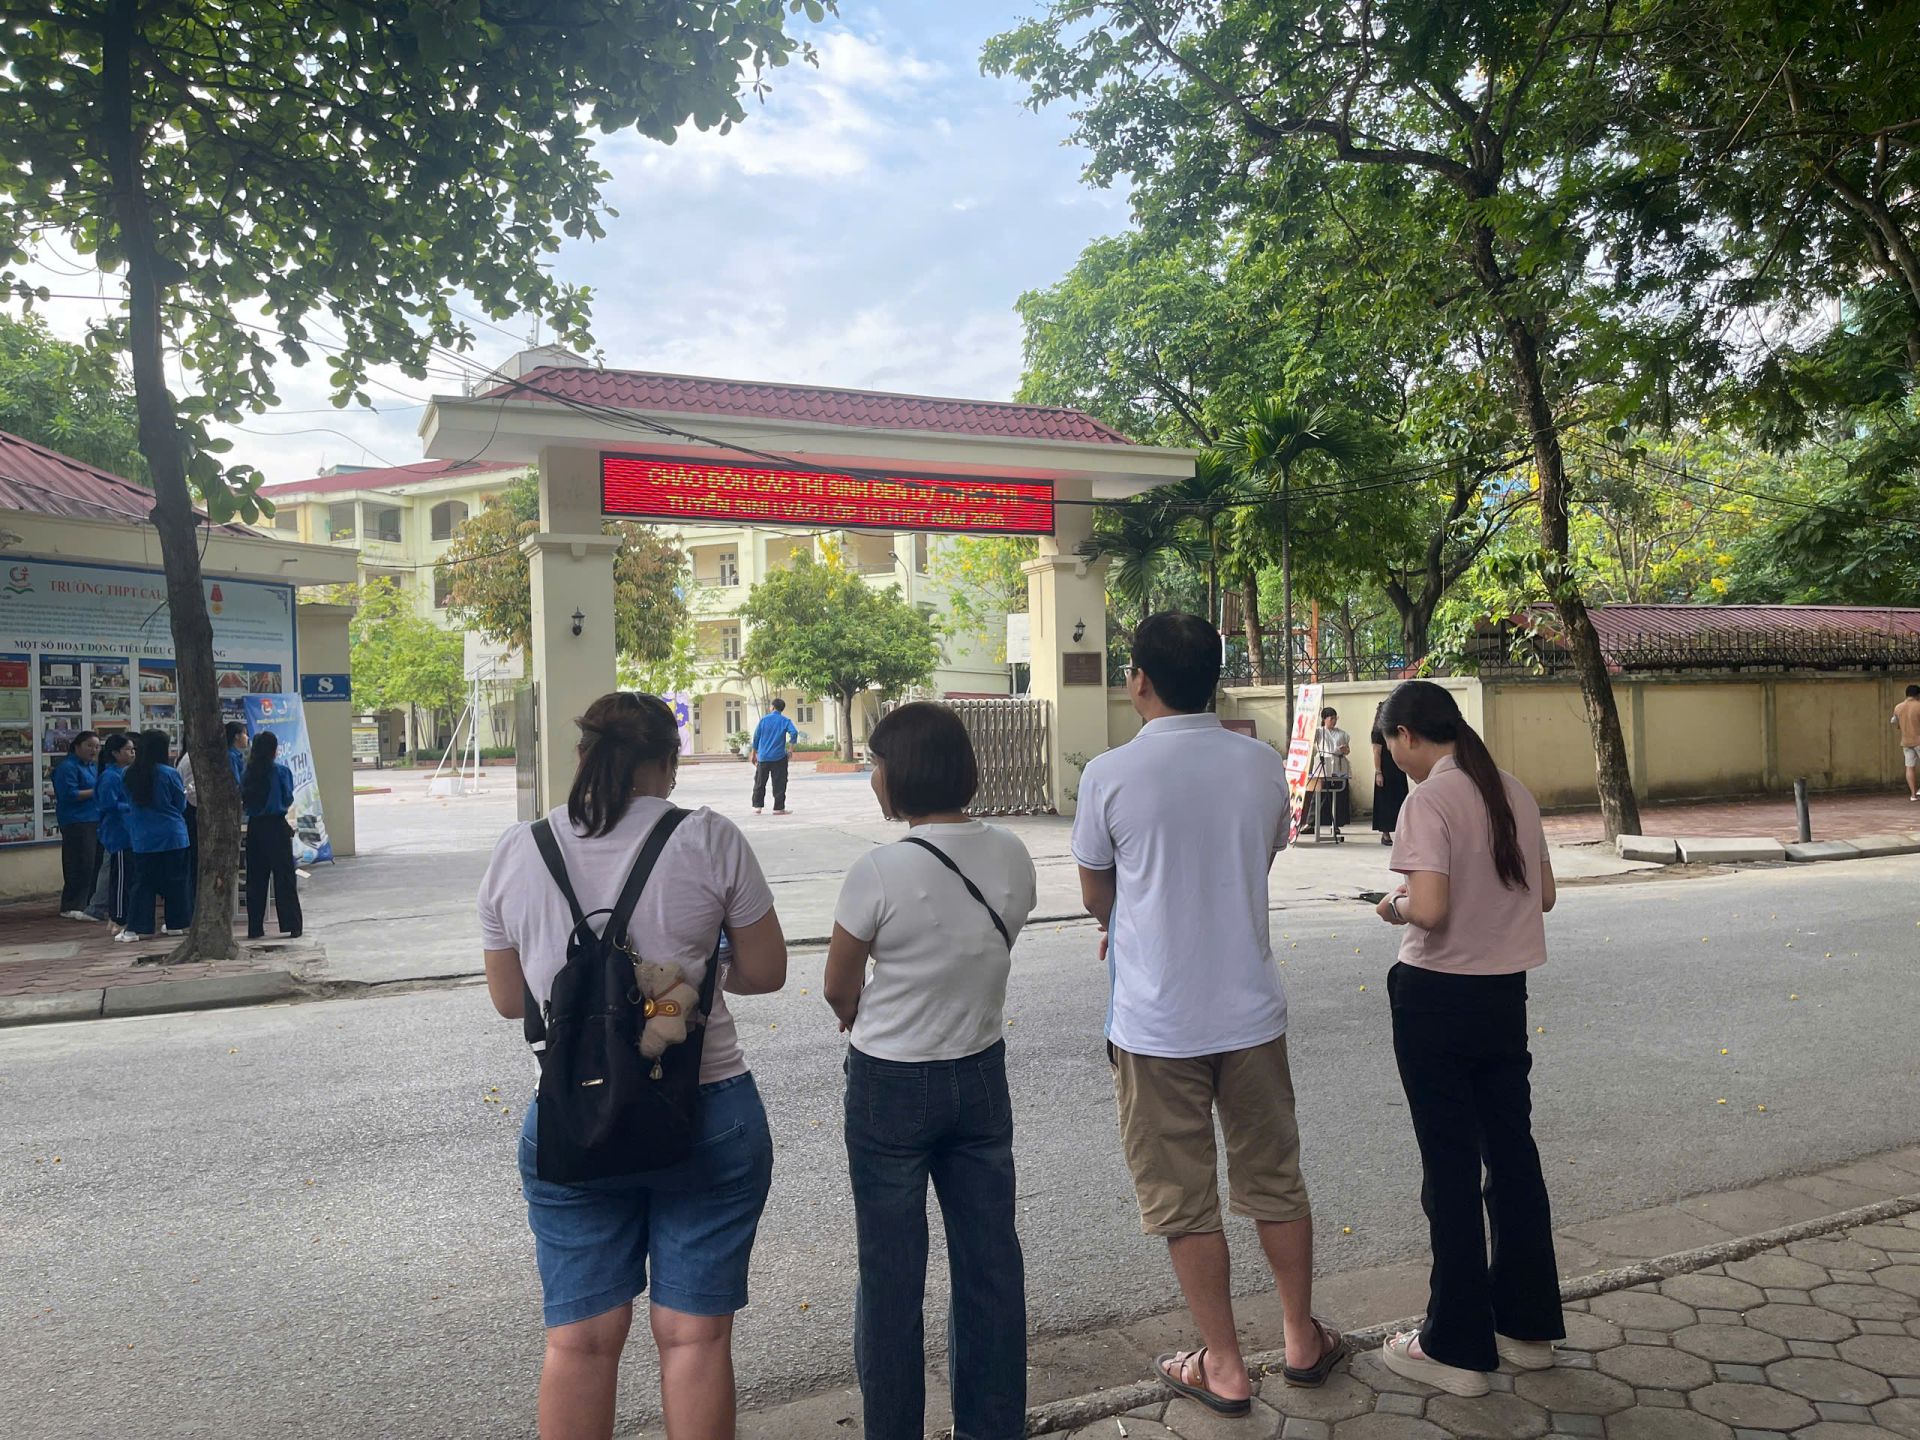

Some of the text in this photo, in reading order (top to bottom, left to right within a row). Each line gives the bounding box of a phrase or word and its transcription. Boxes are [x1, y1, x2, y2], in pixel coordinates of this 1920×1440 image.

[648, 466, 703, 488] CHÀO
[707, 469, 749, 490] ĐÓN
[752, 473, 792, 493] CÁC
[795, 476, 823, 495] THÍ
[828, 479, 868, 498] SINH
[665, 491, 730, 512] TUYỂN
[781, 500, 820, 517] VÀO
[884, 507, 928, 522] THPT
[106, 584, 137, 598] THPT
[317, 676, 334, 693] 8
[291, 752, 308, 771] THI
